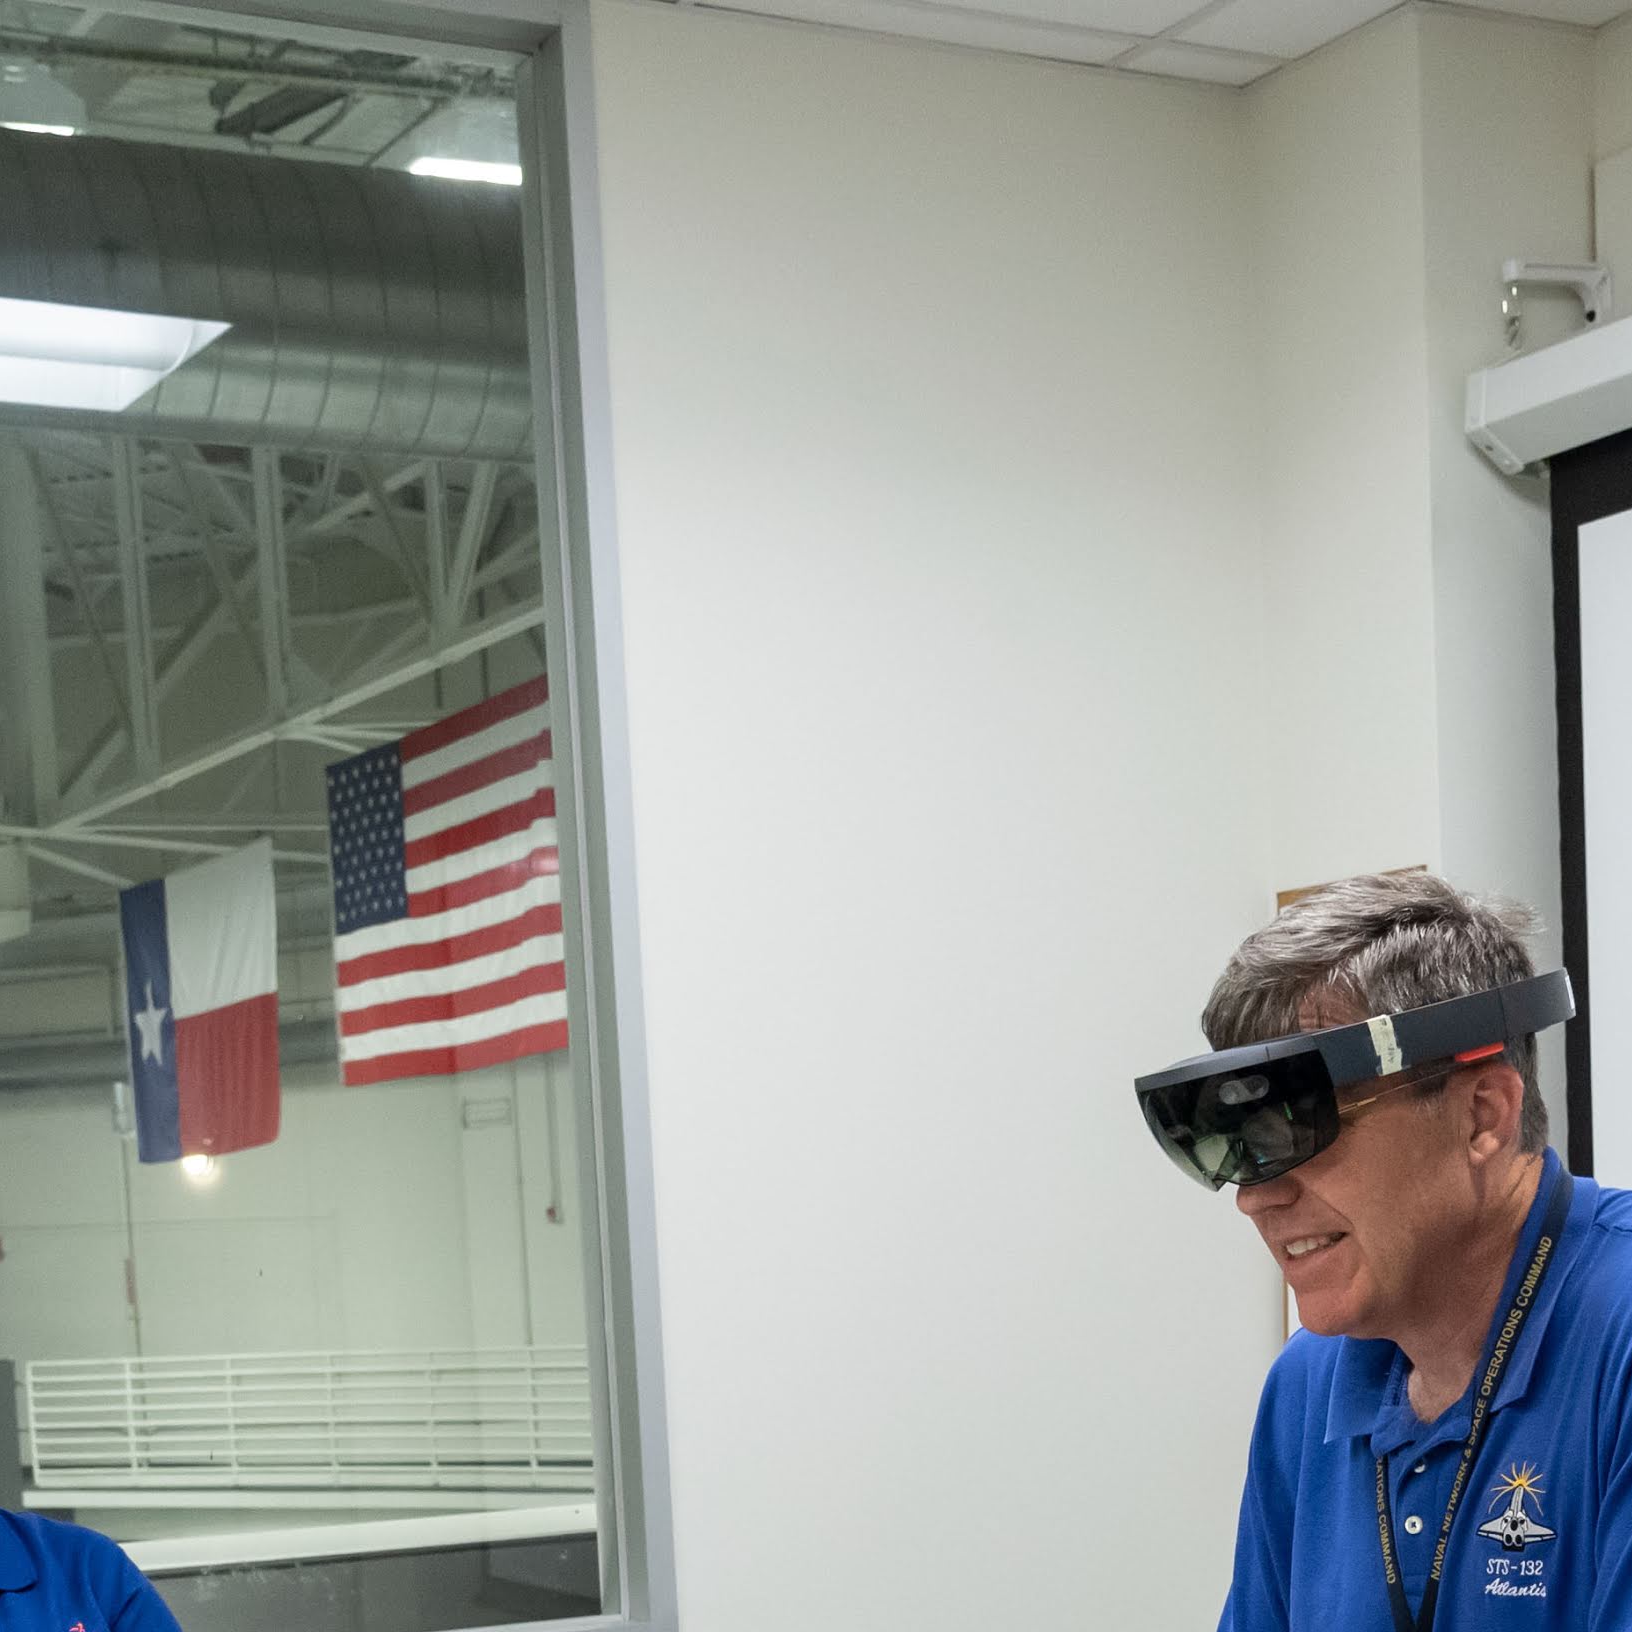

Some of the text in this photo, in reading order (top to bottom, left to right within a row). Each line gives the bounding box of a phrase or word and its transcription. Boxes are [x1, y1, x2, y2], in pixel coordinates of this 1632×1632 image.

[1430, 1235, 1553, 1581] NAVAL NETWORK & SPACE OPERATIONS COMMAND
[1378, 1514, 1396, 1585] COMMAND
[1485, 1558, 1544, 1577] STS-132
[1484, 1577, 1547, 1599] Atlantis
